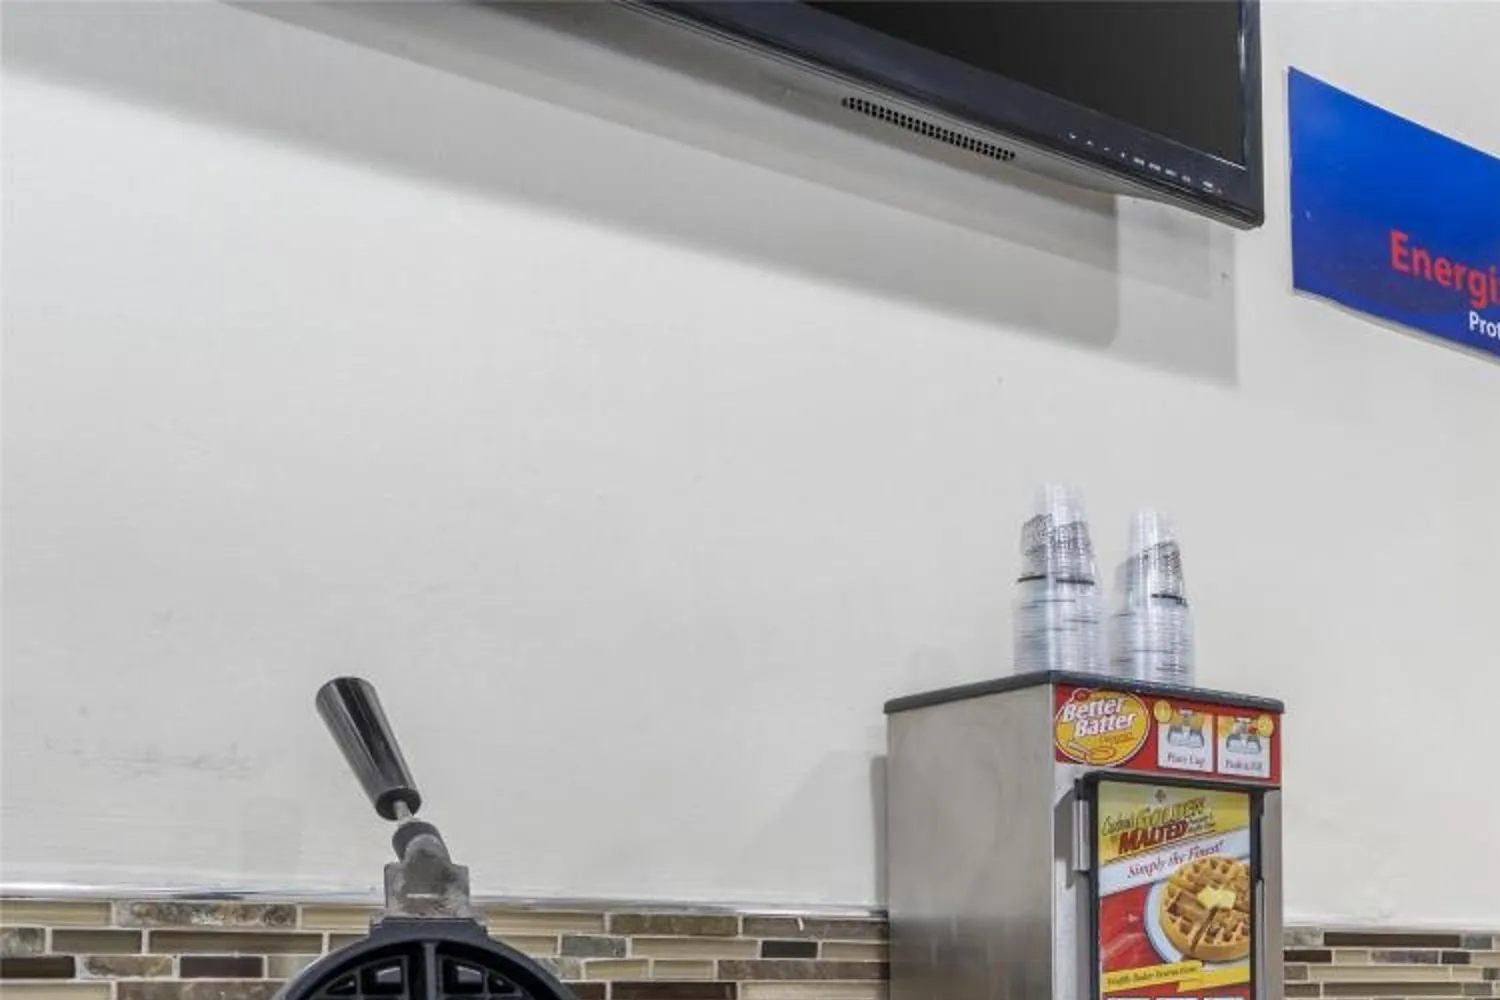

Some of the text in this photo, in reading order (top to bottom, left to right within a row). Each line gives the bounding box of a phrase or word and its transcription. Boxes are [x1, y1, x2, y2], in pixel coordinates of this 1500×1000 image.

[1062, 697, 1125, 723] Better
[1074, 713, 1137, 738] Batter
[1117, 819, 1188, 855] MALTED
[1127, 856, 1165, 879] Simply
